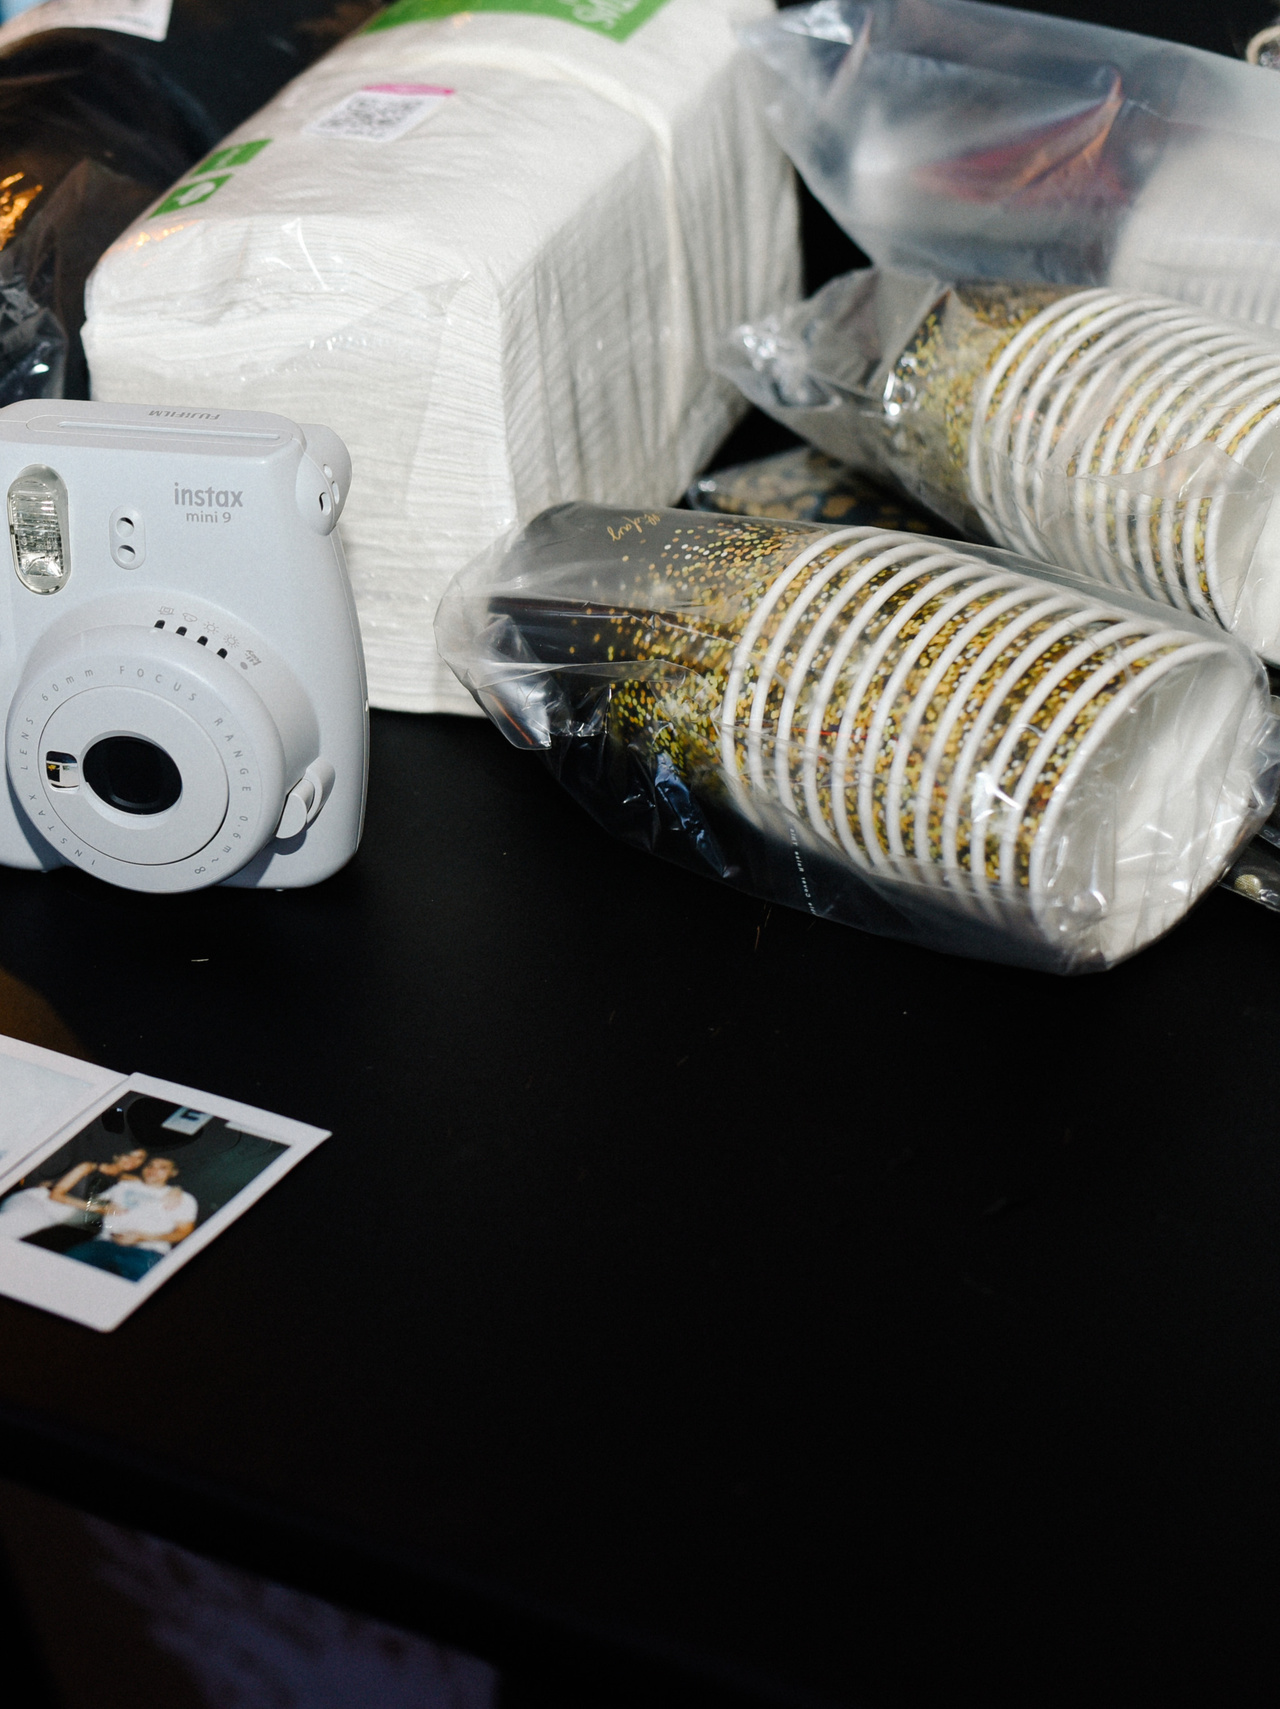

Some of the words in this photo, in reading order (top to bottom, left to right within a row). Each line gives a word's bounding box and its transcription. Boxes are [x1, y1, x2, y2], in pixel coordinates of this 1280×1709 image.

[148, 410, 221, 420] FUJIFILM
[174, 481, 244, 508] instax
[186, 510, 218, 523] mini
[222, 511, 232, 524] 9
[42, 667, 95, 703] 60mm
[119, 665, 199, 703] FOCUS
[20, 716, 35, 771] LENS
[214, 716, 252, 793] RANGE
[28, 793, 96, 866] INSTAX
